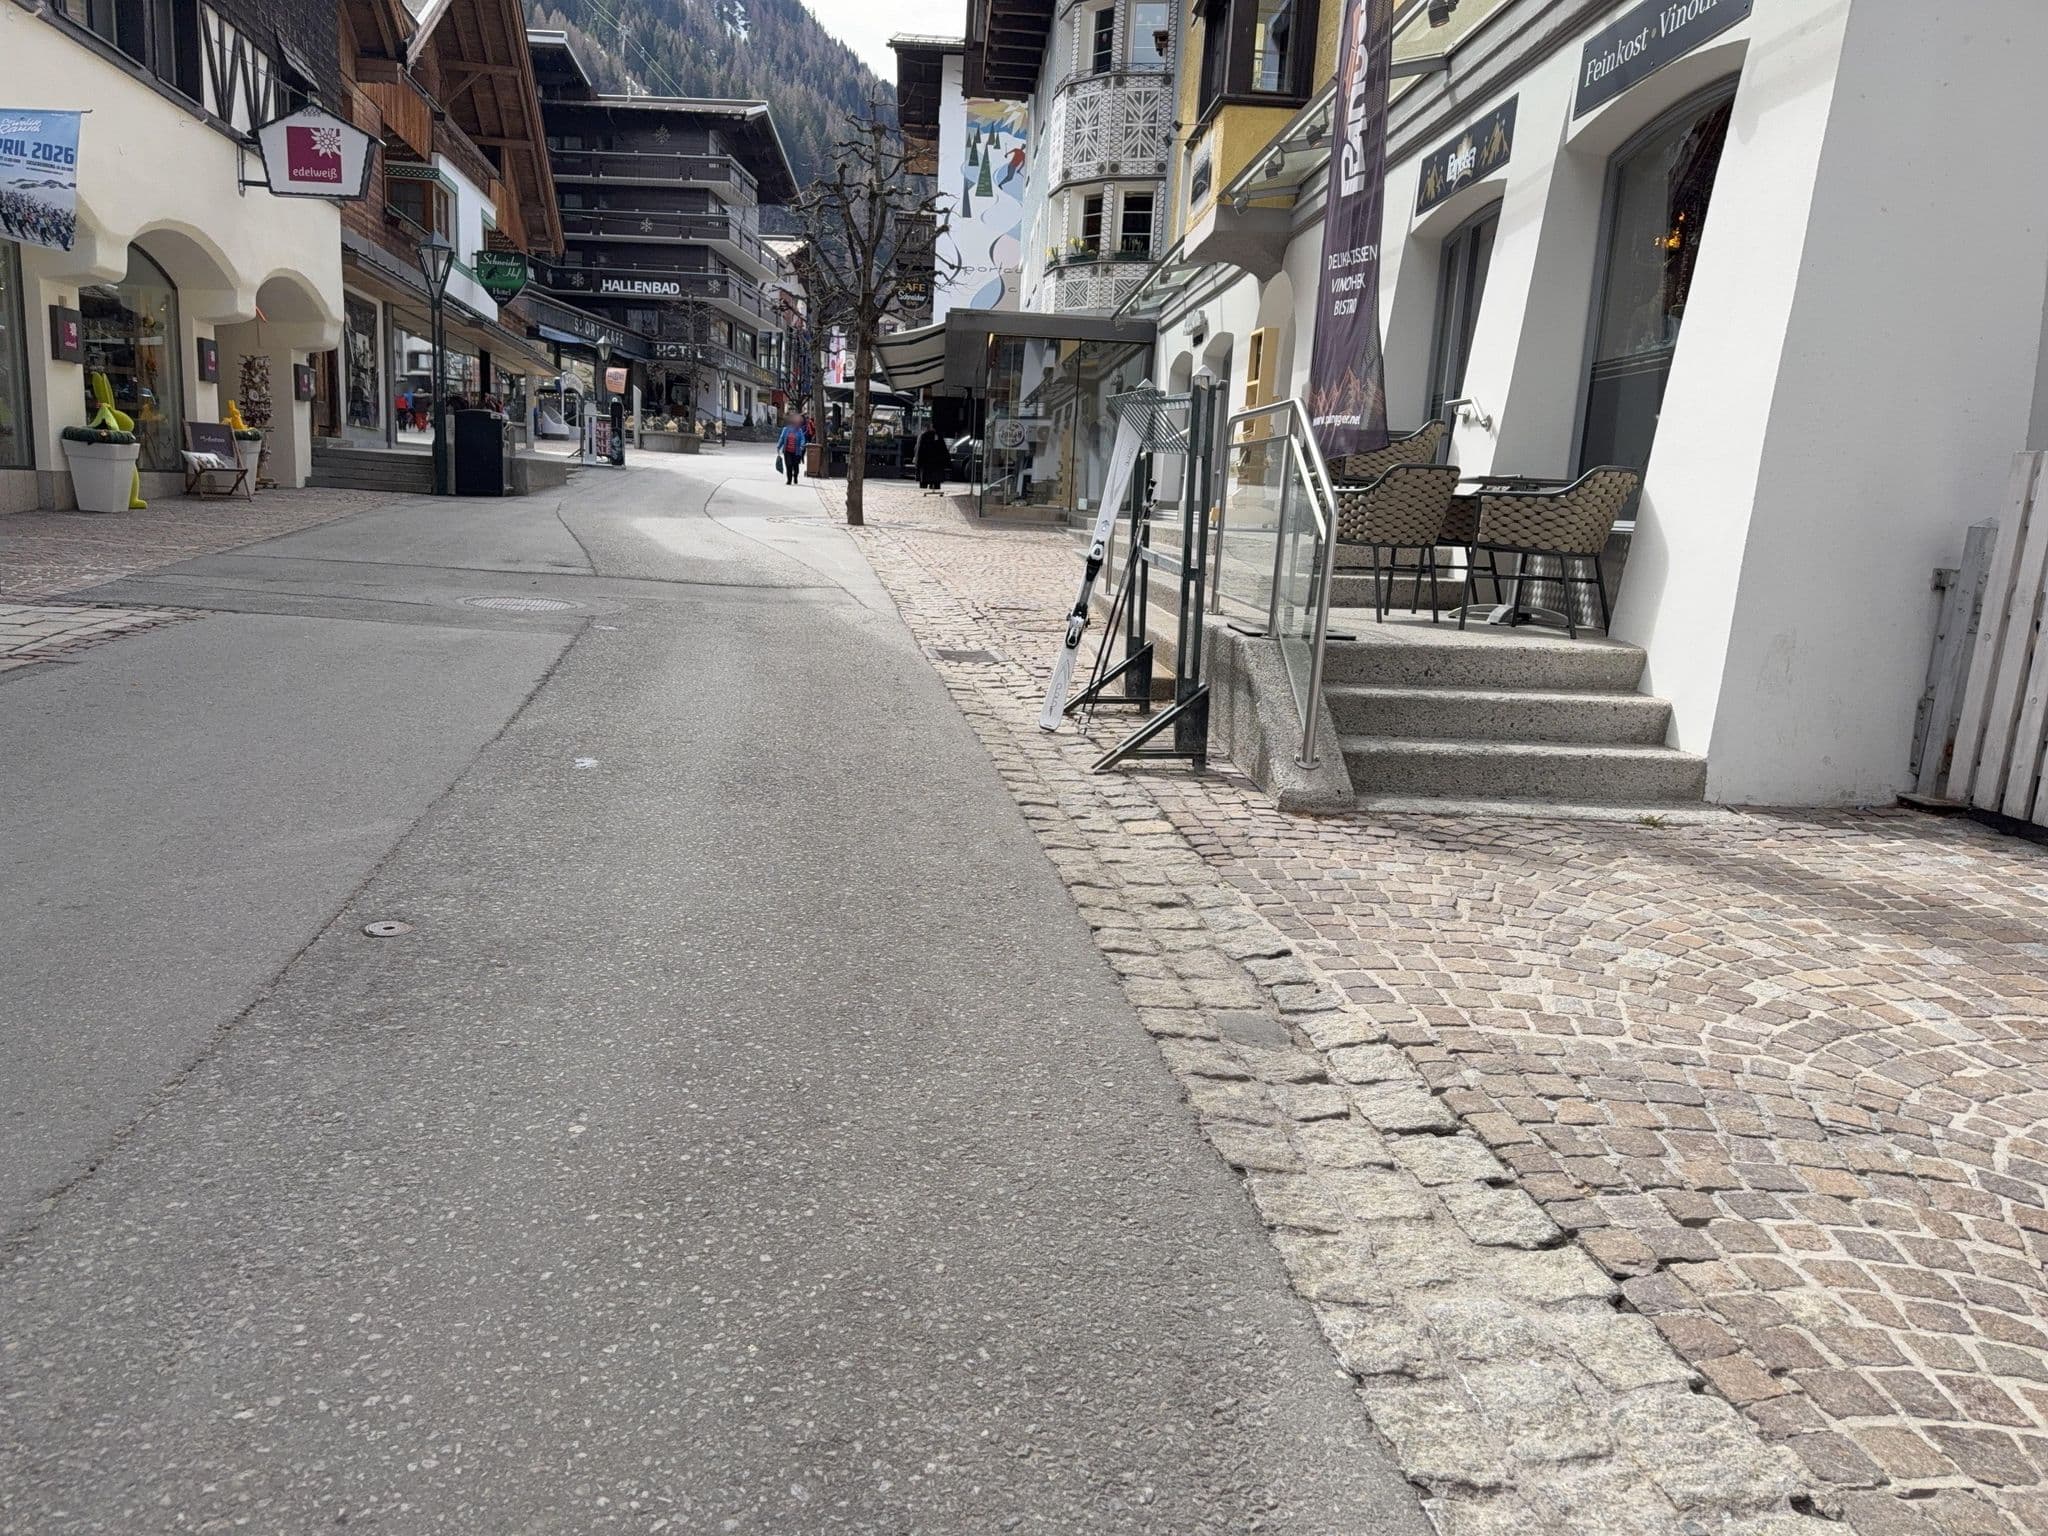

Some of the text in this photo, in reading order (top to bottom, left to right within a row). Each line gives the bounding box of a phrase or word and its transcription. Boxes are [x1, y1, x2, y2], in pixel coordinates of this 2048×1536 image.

[1584, 27, 1649, 88] Feinkost
[0, 138, 28, 157] RIL
[31, 142, 75, 165] 2026
[292, 166, 338, 180] edelweiß
[602, 279, 680, 295] HALLENBAD
